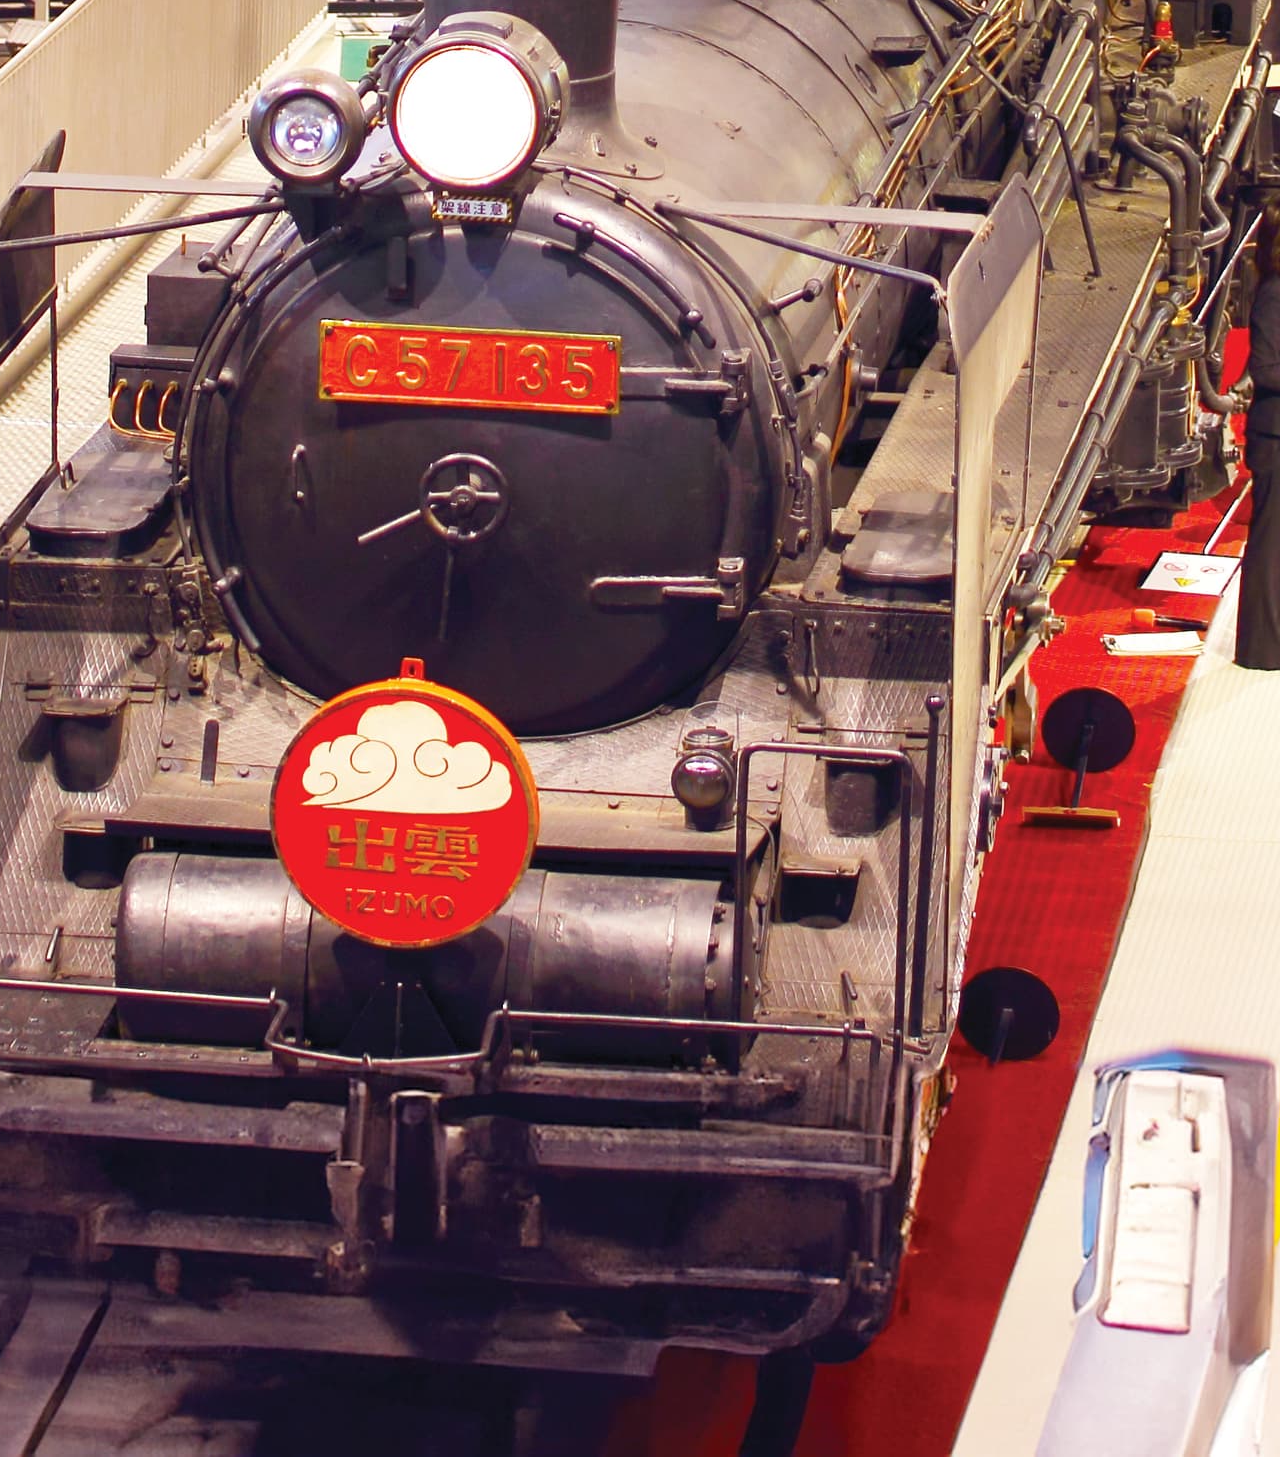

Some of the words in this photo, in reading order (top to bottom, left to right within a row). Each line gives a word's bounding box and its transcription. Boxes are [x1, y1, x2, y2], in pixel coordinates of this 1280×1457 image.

[441, 199, 504, 216] 架線注意
[325, 817, 480, 882] 出雲
[344, 887, 457, 921] IZUMO
